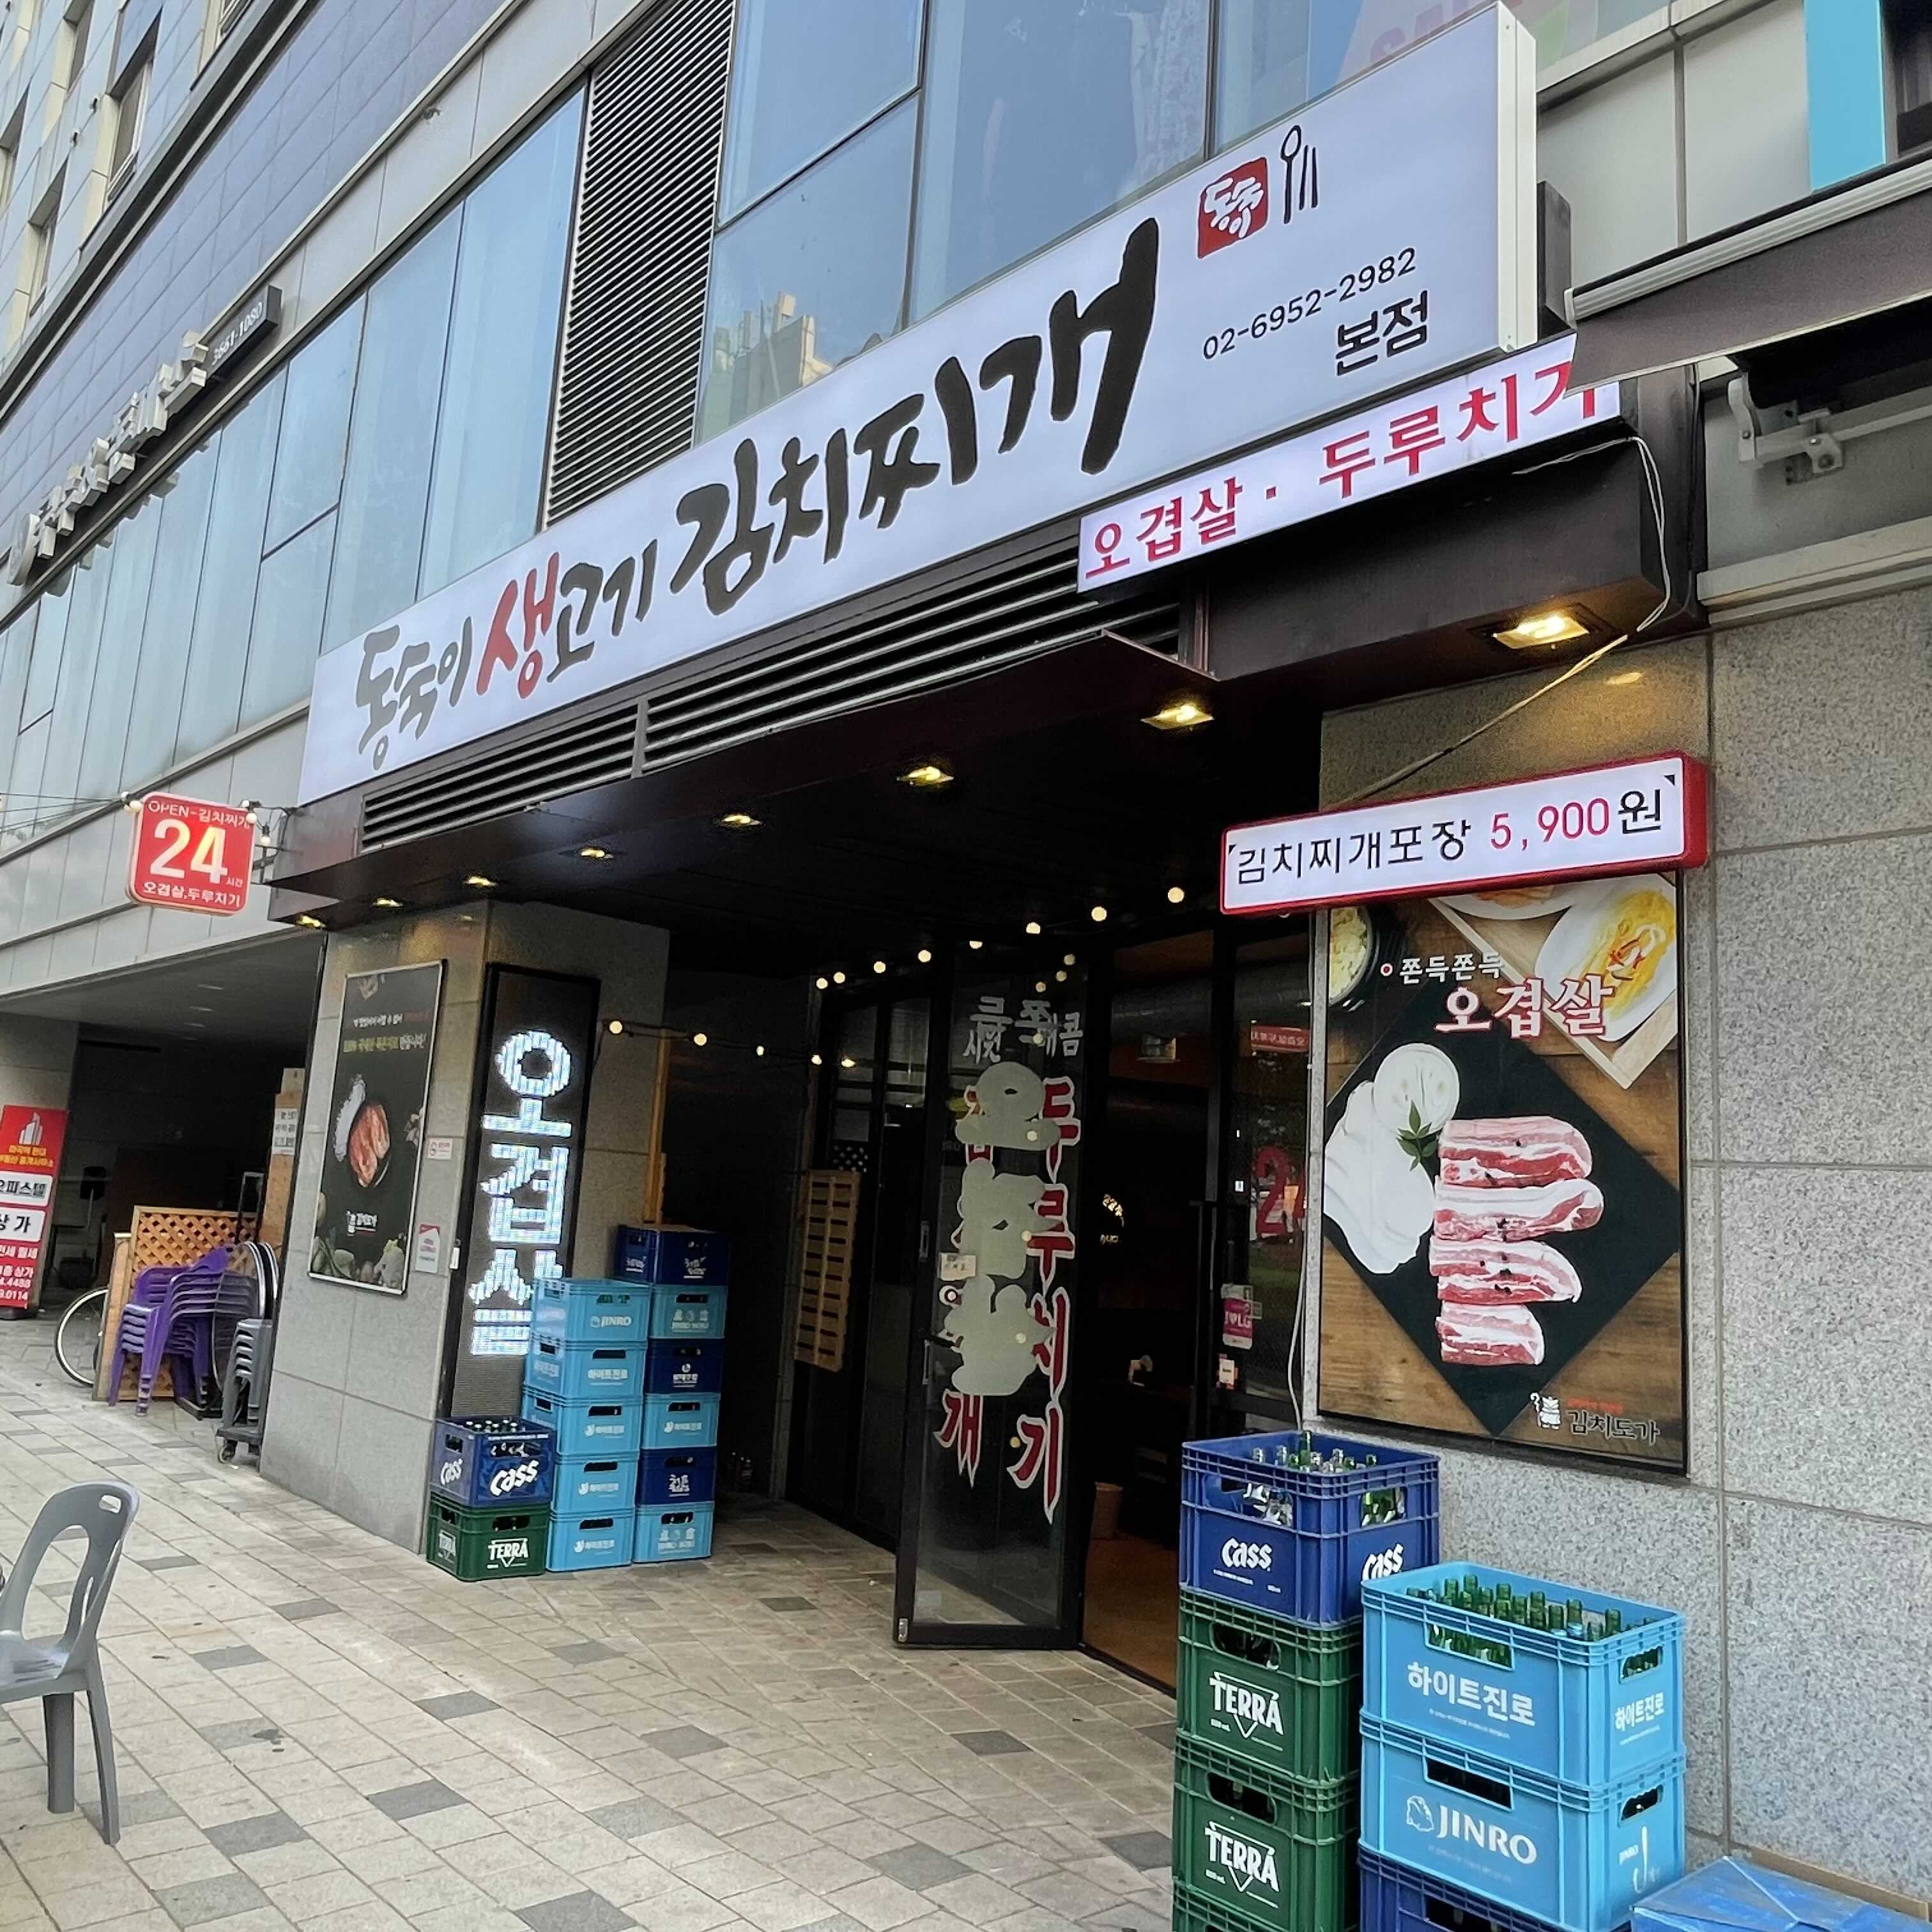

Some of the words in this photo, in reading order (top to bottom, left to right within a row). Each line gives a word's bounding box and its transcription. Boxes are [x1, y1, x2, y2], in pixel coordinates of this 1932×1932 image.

[1203, 247, 1416, 360] 02-6952-2982
[1336, 290, 1428, 376] 본점
[476, 539, 657, 699] 생고기
[670, 217, 1159, 616] 김치찌개
[1085, 475, 1243, 579] 오겹살
[1319, 360, 1595, 499] 두루치기
[150, 818, 228, 884] 24
[1238, 818, 1471, 885] 김치찌개포장
[1399, 951, 1505, 986] 쫀득쫀득
[1434, 974, 1615, 1039] 오겹살
[468, 1030, 572, 1356] 오겹살
[1567, 1409, 1660, 1446] 김치도가
[490, 1459, 540, 1496] Cass
[487, 1539, 529, 1561] TERRA
[1222, 1537, 1273, 1570] Cass
[1361, 1543, 1404, 1582] Cass
[1209, 1674, 1284, 1736] TERRA
[1407, 1661, 1536, 1727] 하이트진로
[1614, 1692, 1665, 1732] 하이트진로
[1204, 1824, 1280, 1892] TERRA
[1437, 1804, 1538, 1865] JINRO
